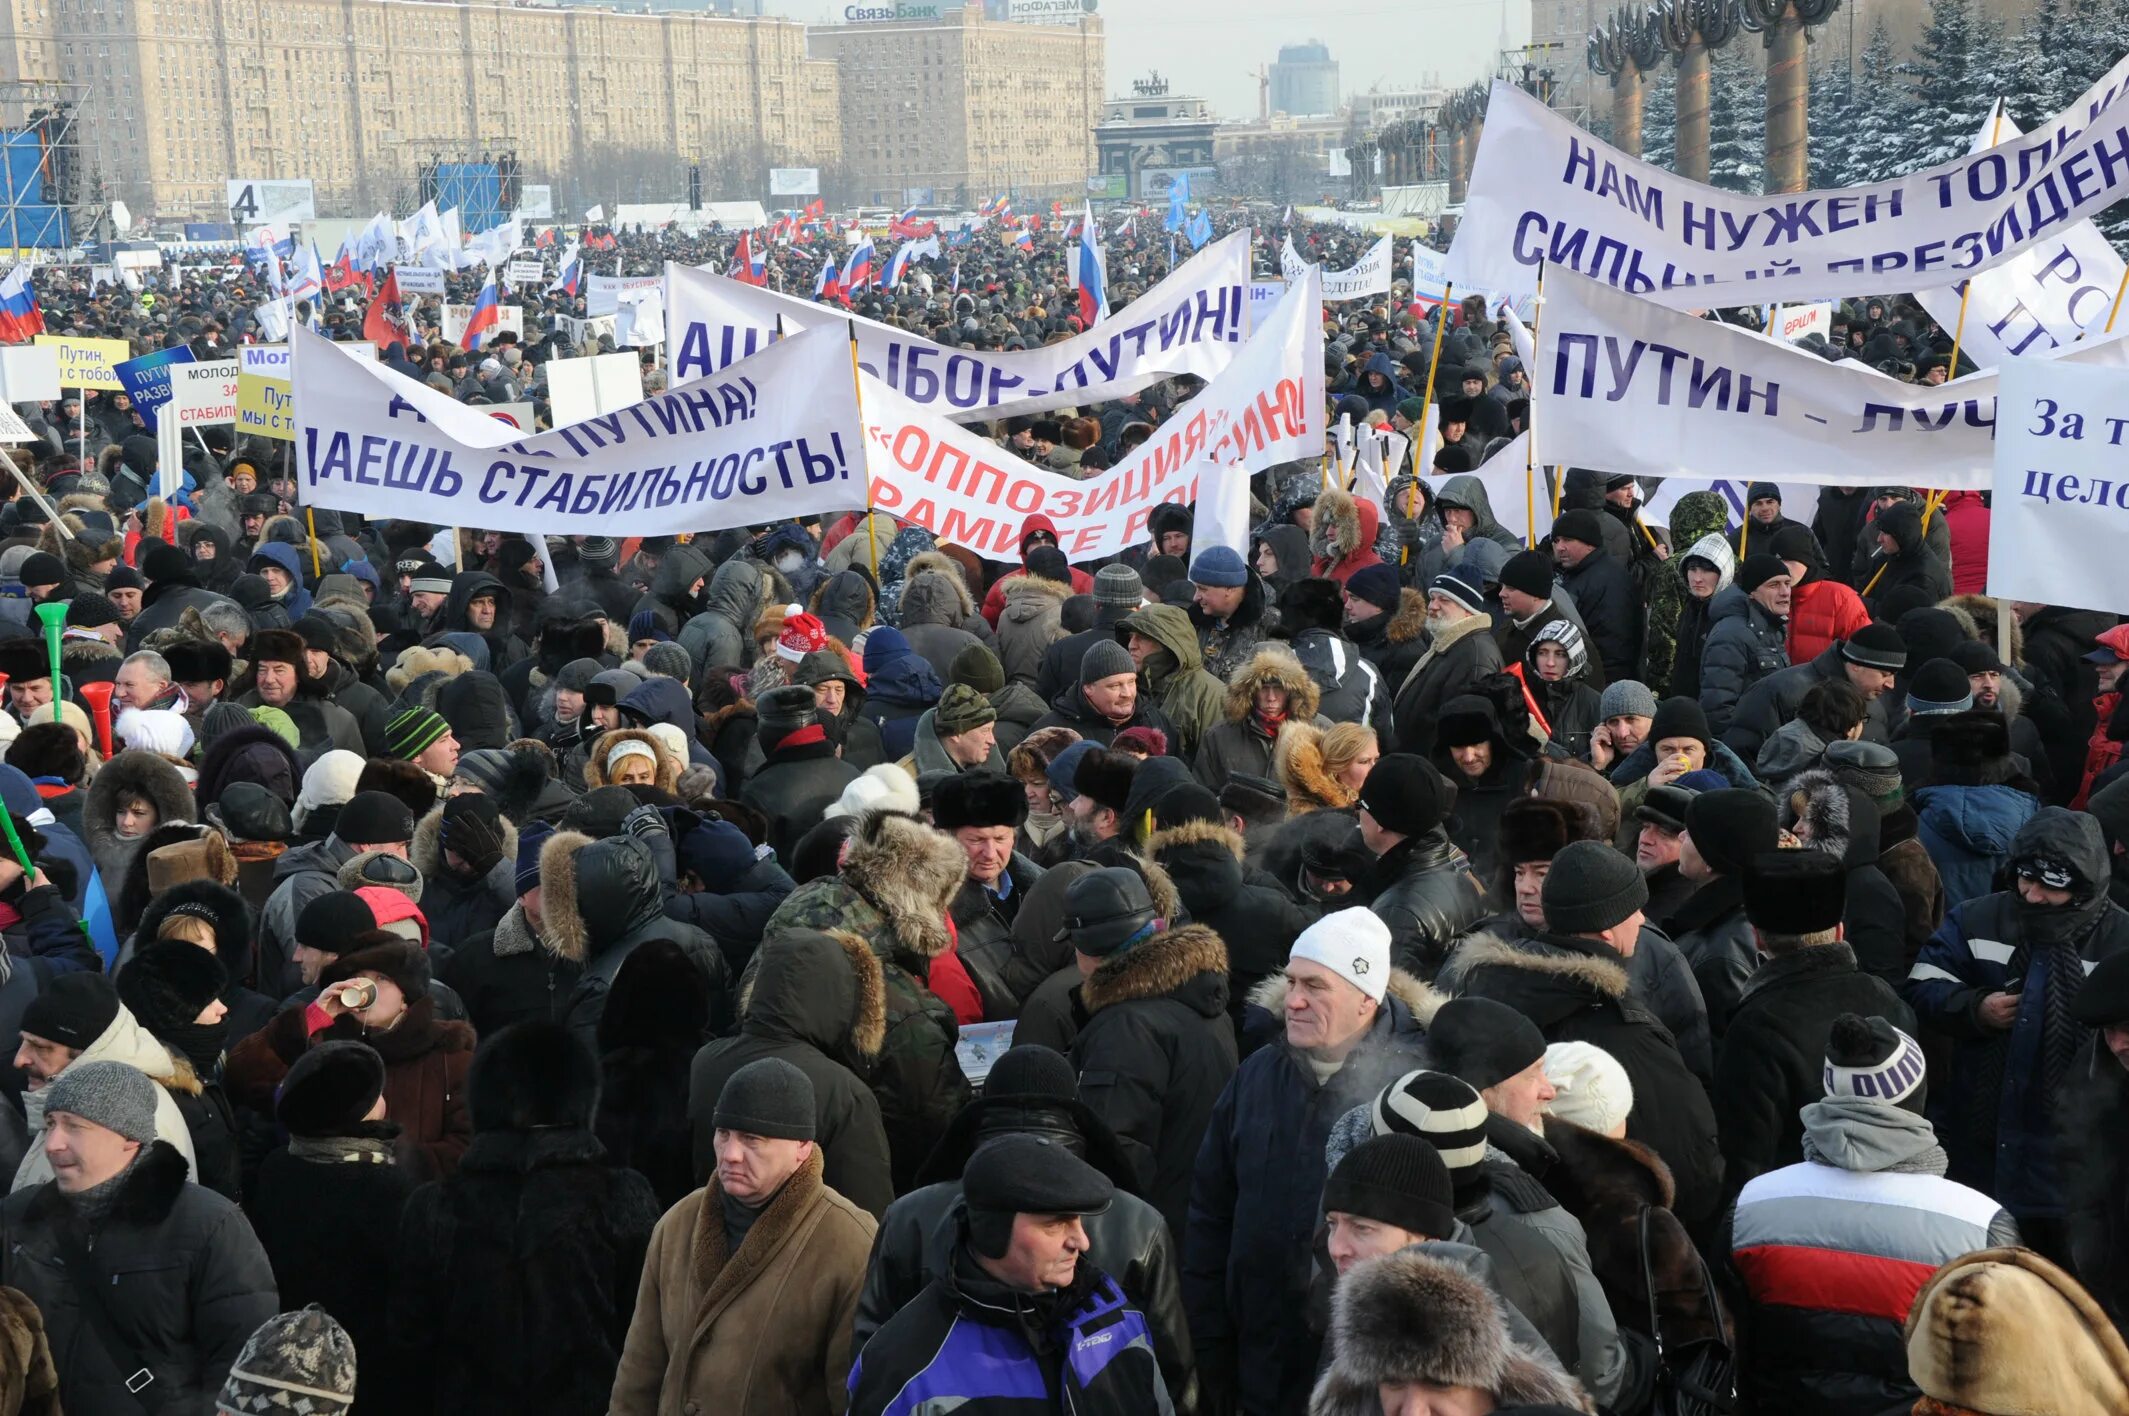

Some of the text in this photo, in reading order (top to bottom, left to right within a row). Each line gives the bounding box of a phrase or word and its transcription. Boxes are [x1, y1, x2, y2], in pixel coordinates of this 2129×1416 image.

[230, 184, 259, 218] 4
[1562, 136, 1664, 232] НАМ
[1683, 190, 1904, 251] НУЖЕН
[60, 344, 106, 365] Путин,
[1552, 332, 1781, 417] ПУТИН
[242, 409, 266, 426] мы
[271, 415, 279, 428] с
[2028, 398, 2085, 441] За
[479, 432, 849, 515] СТАБИЛЬНОСТЬ!
